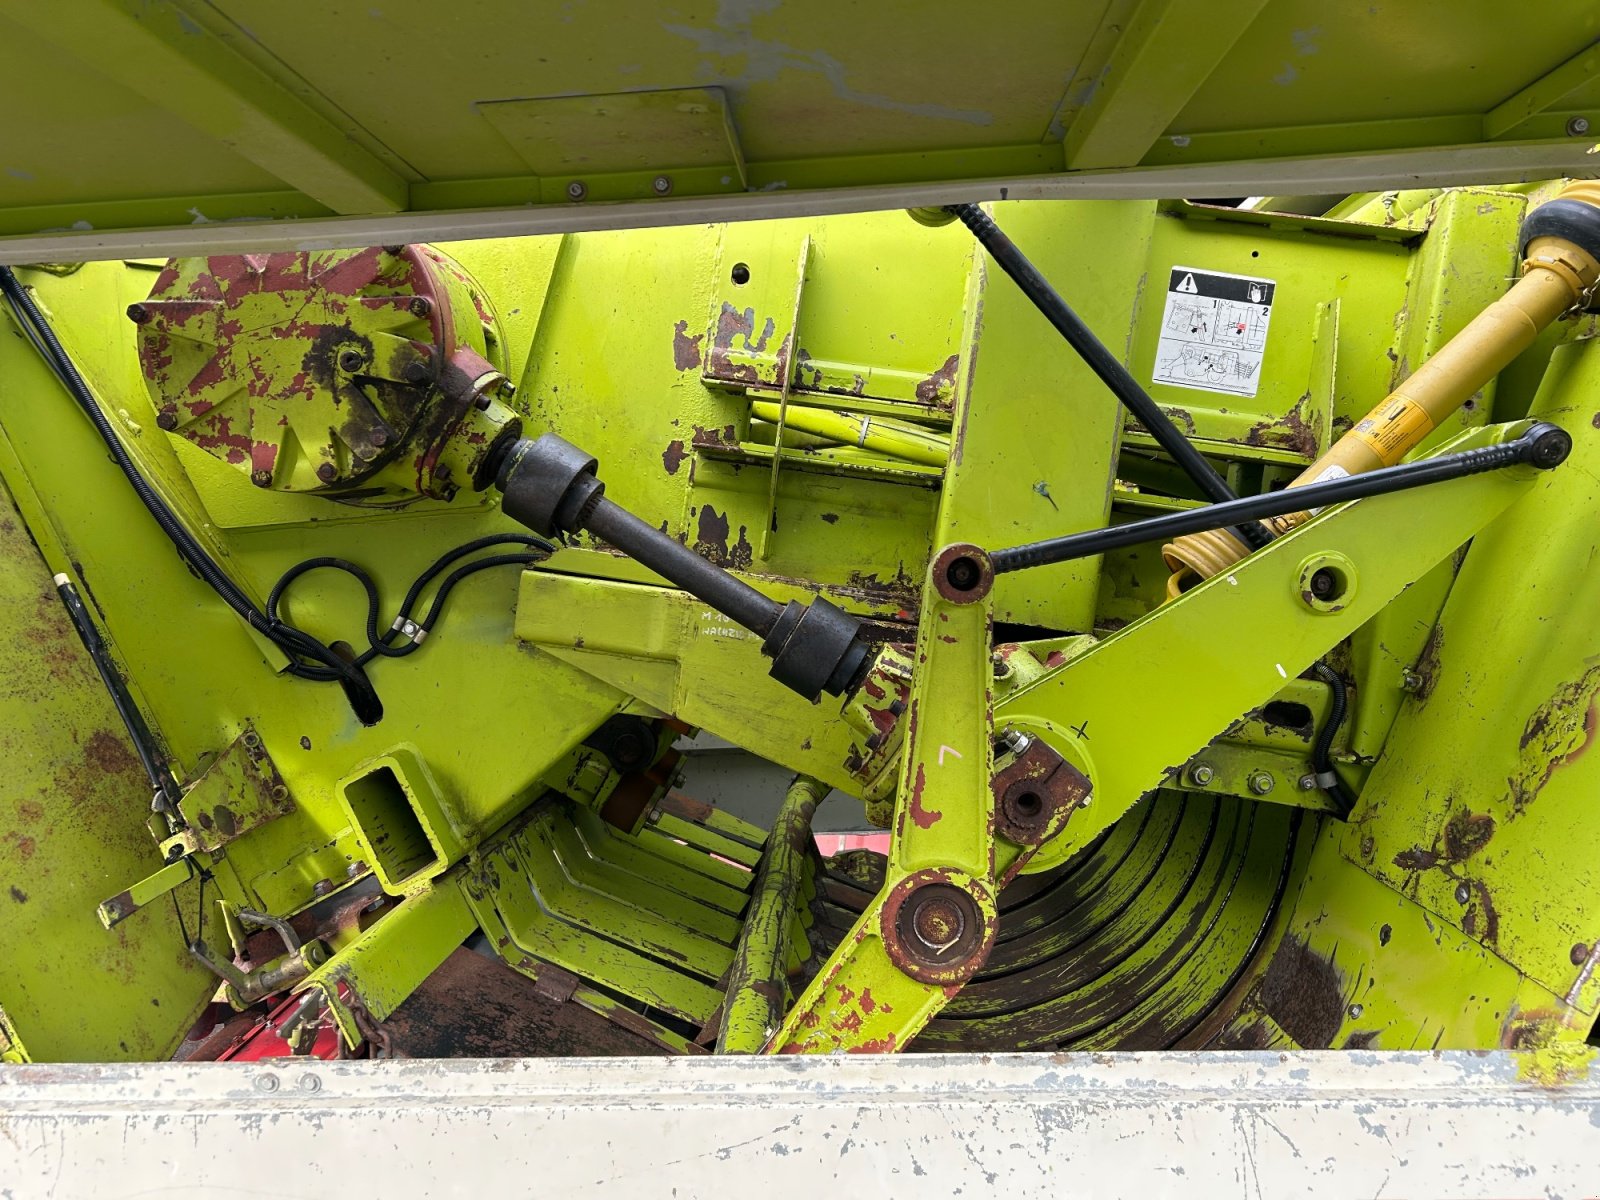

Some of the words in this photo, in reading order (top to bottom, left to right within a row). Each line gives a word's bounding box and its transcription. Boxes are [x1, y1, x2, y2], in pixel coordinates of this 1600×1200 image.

[1213, 300, 1218, 308] 1
[1262, 307, 1269, 316] 2
[702, 612, 712, 621] M
